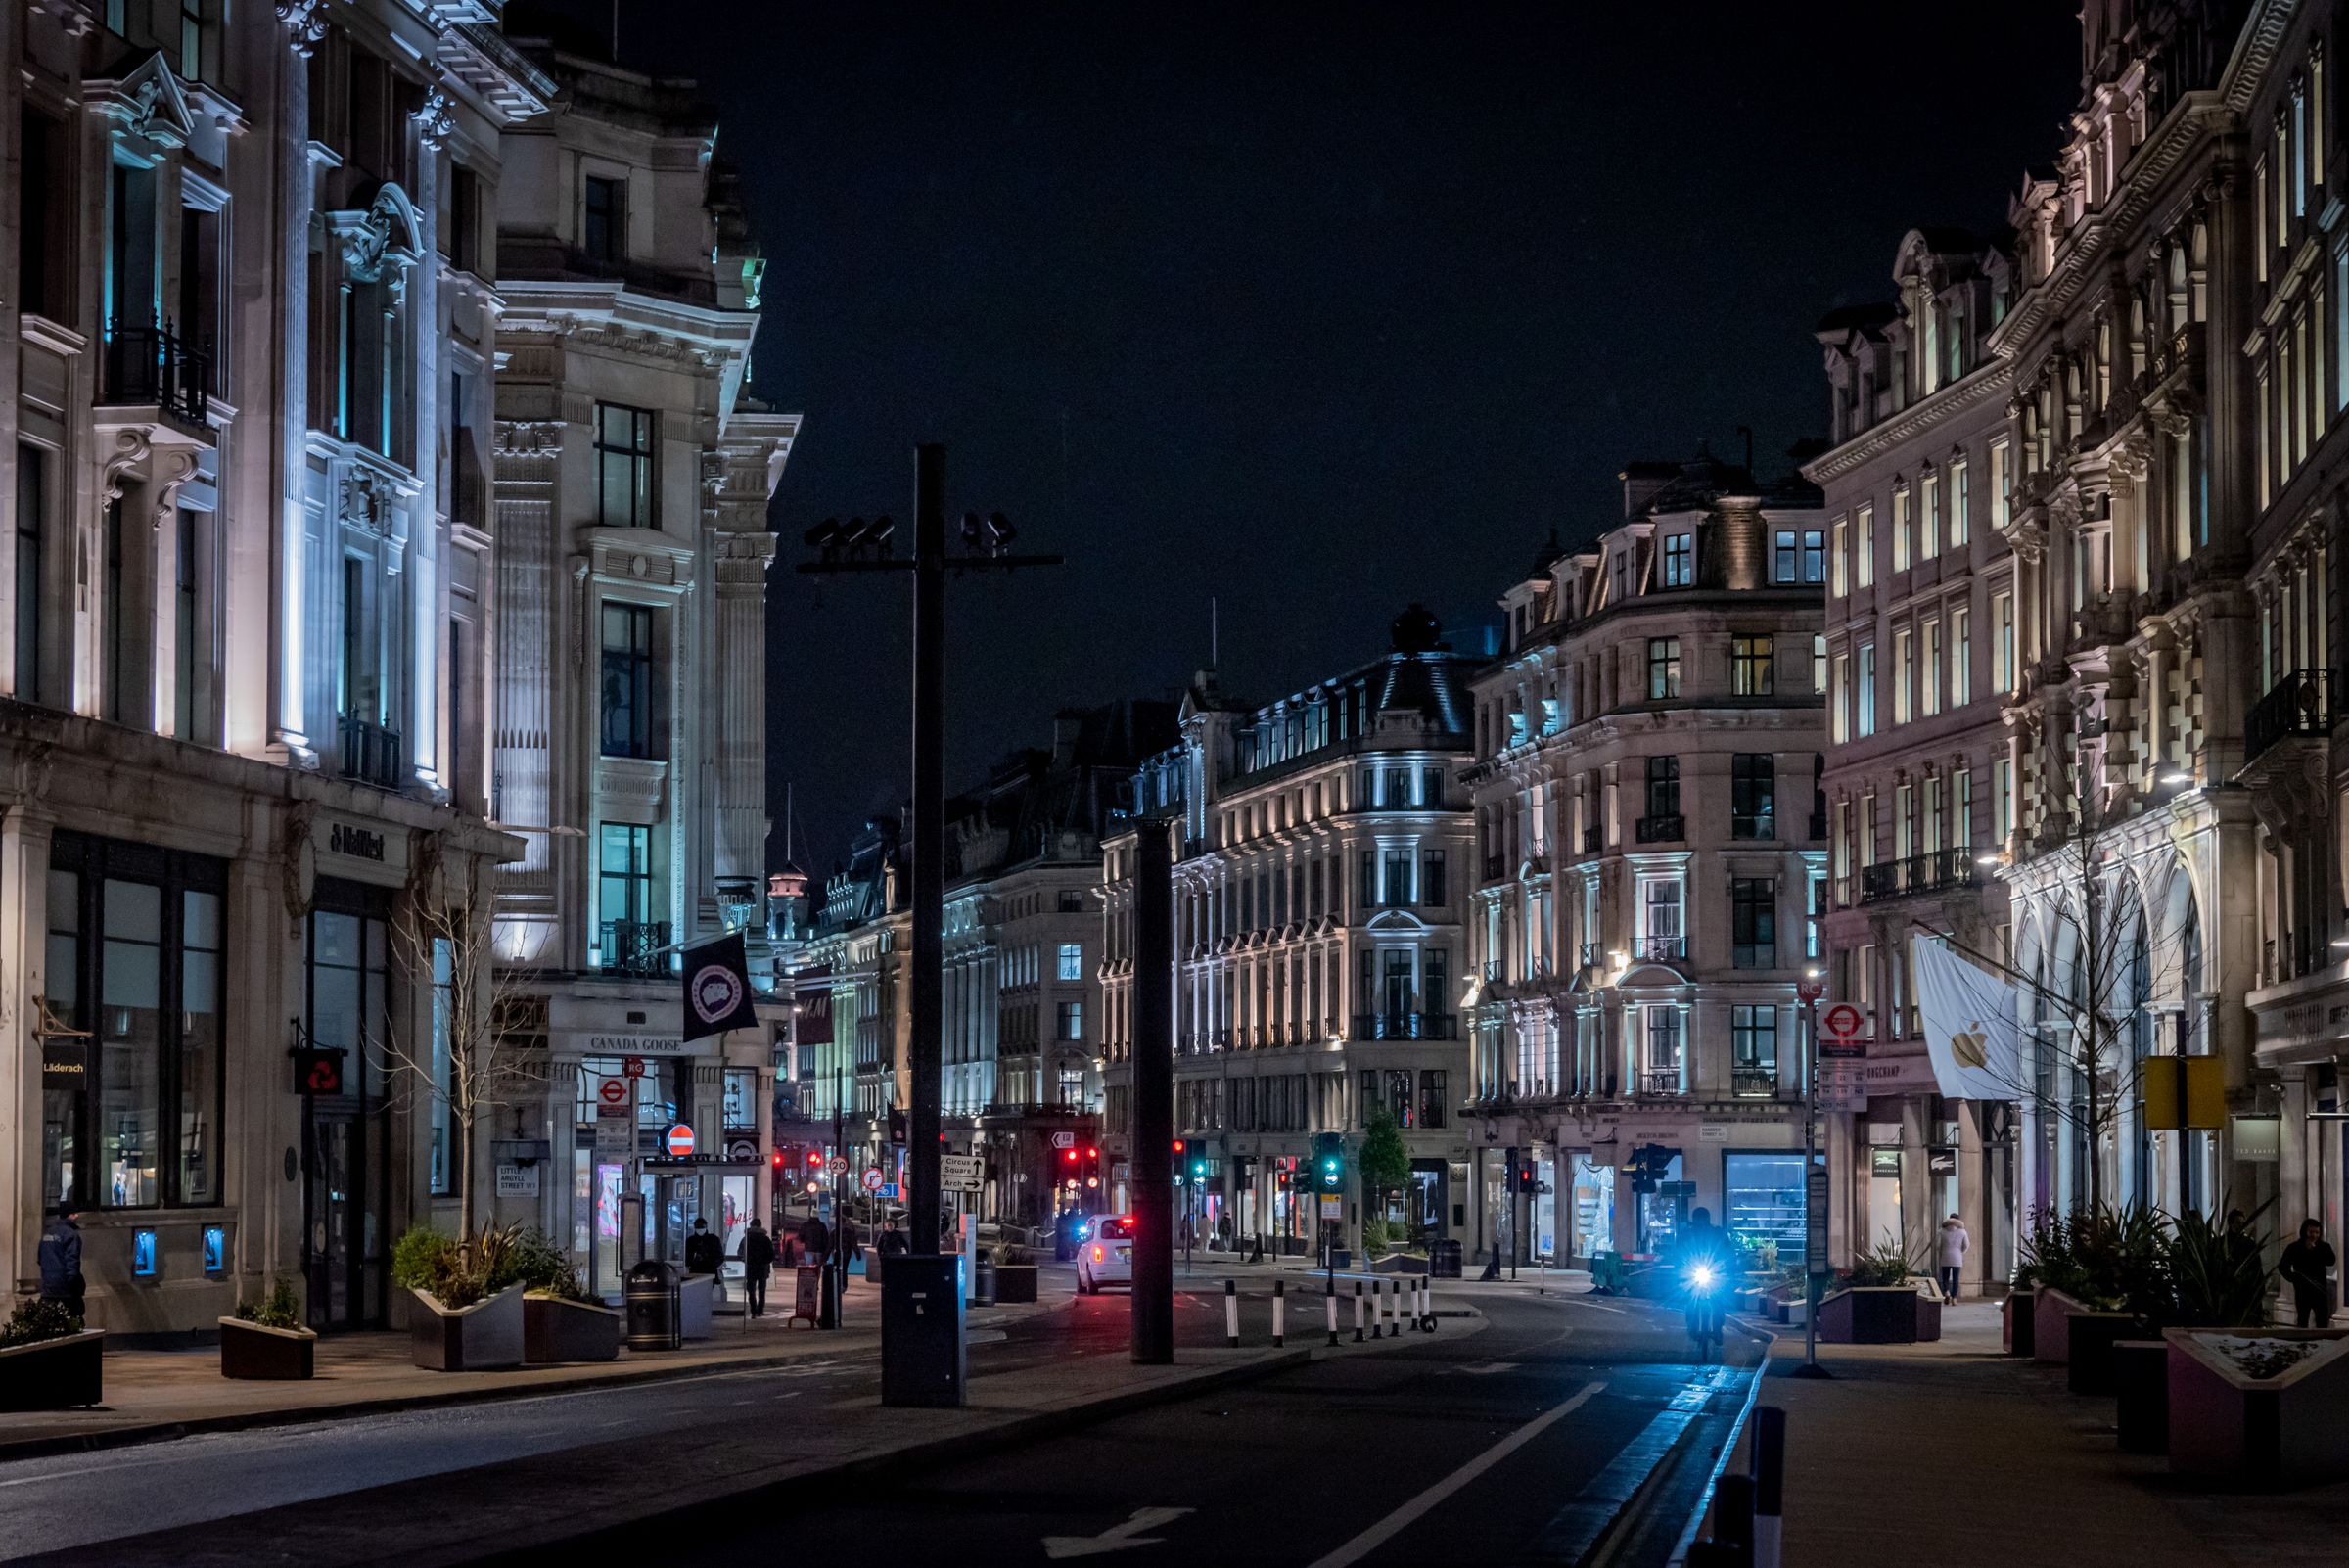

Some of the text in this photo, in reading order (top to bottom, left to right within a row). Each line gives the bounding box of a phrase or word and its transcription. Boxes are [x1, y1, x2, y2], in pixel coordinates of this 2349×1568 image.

[344, 826, 384, 861] NatWest
[1801, 985, 1819, 994] RC
[591, 1038, 681, 1051] CANADA GOOSE
[44, 1063, 84, 1073] Läderach
[628, 1063, 643, 1073] RG
[1866, 1065, 1900, 1079] ONGCHAMP
[832, 1161, 846, 1170] 20
[945, 1157, 971, 1166] Circus
[944, 1166, 972, 1175] Square
